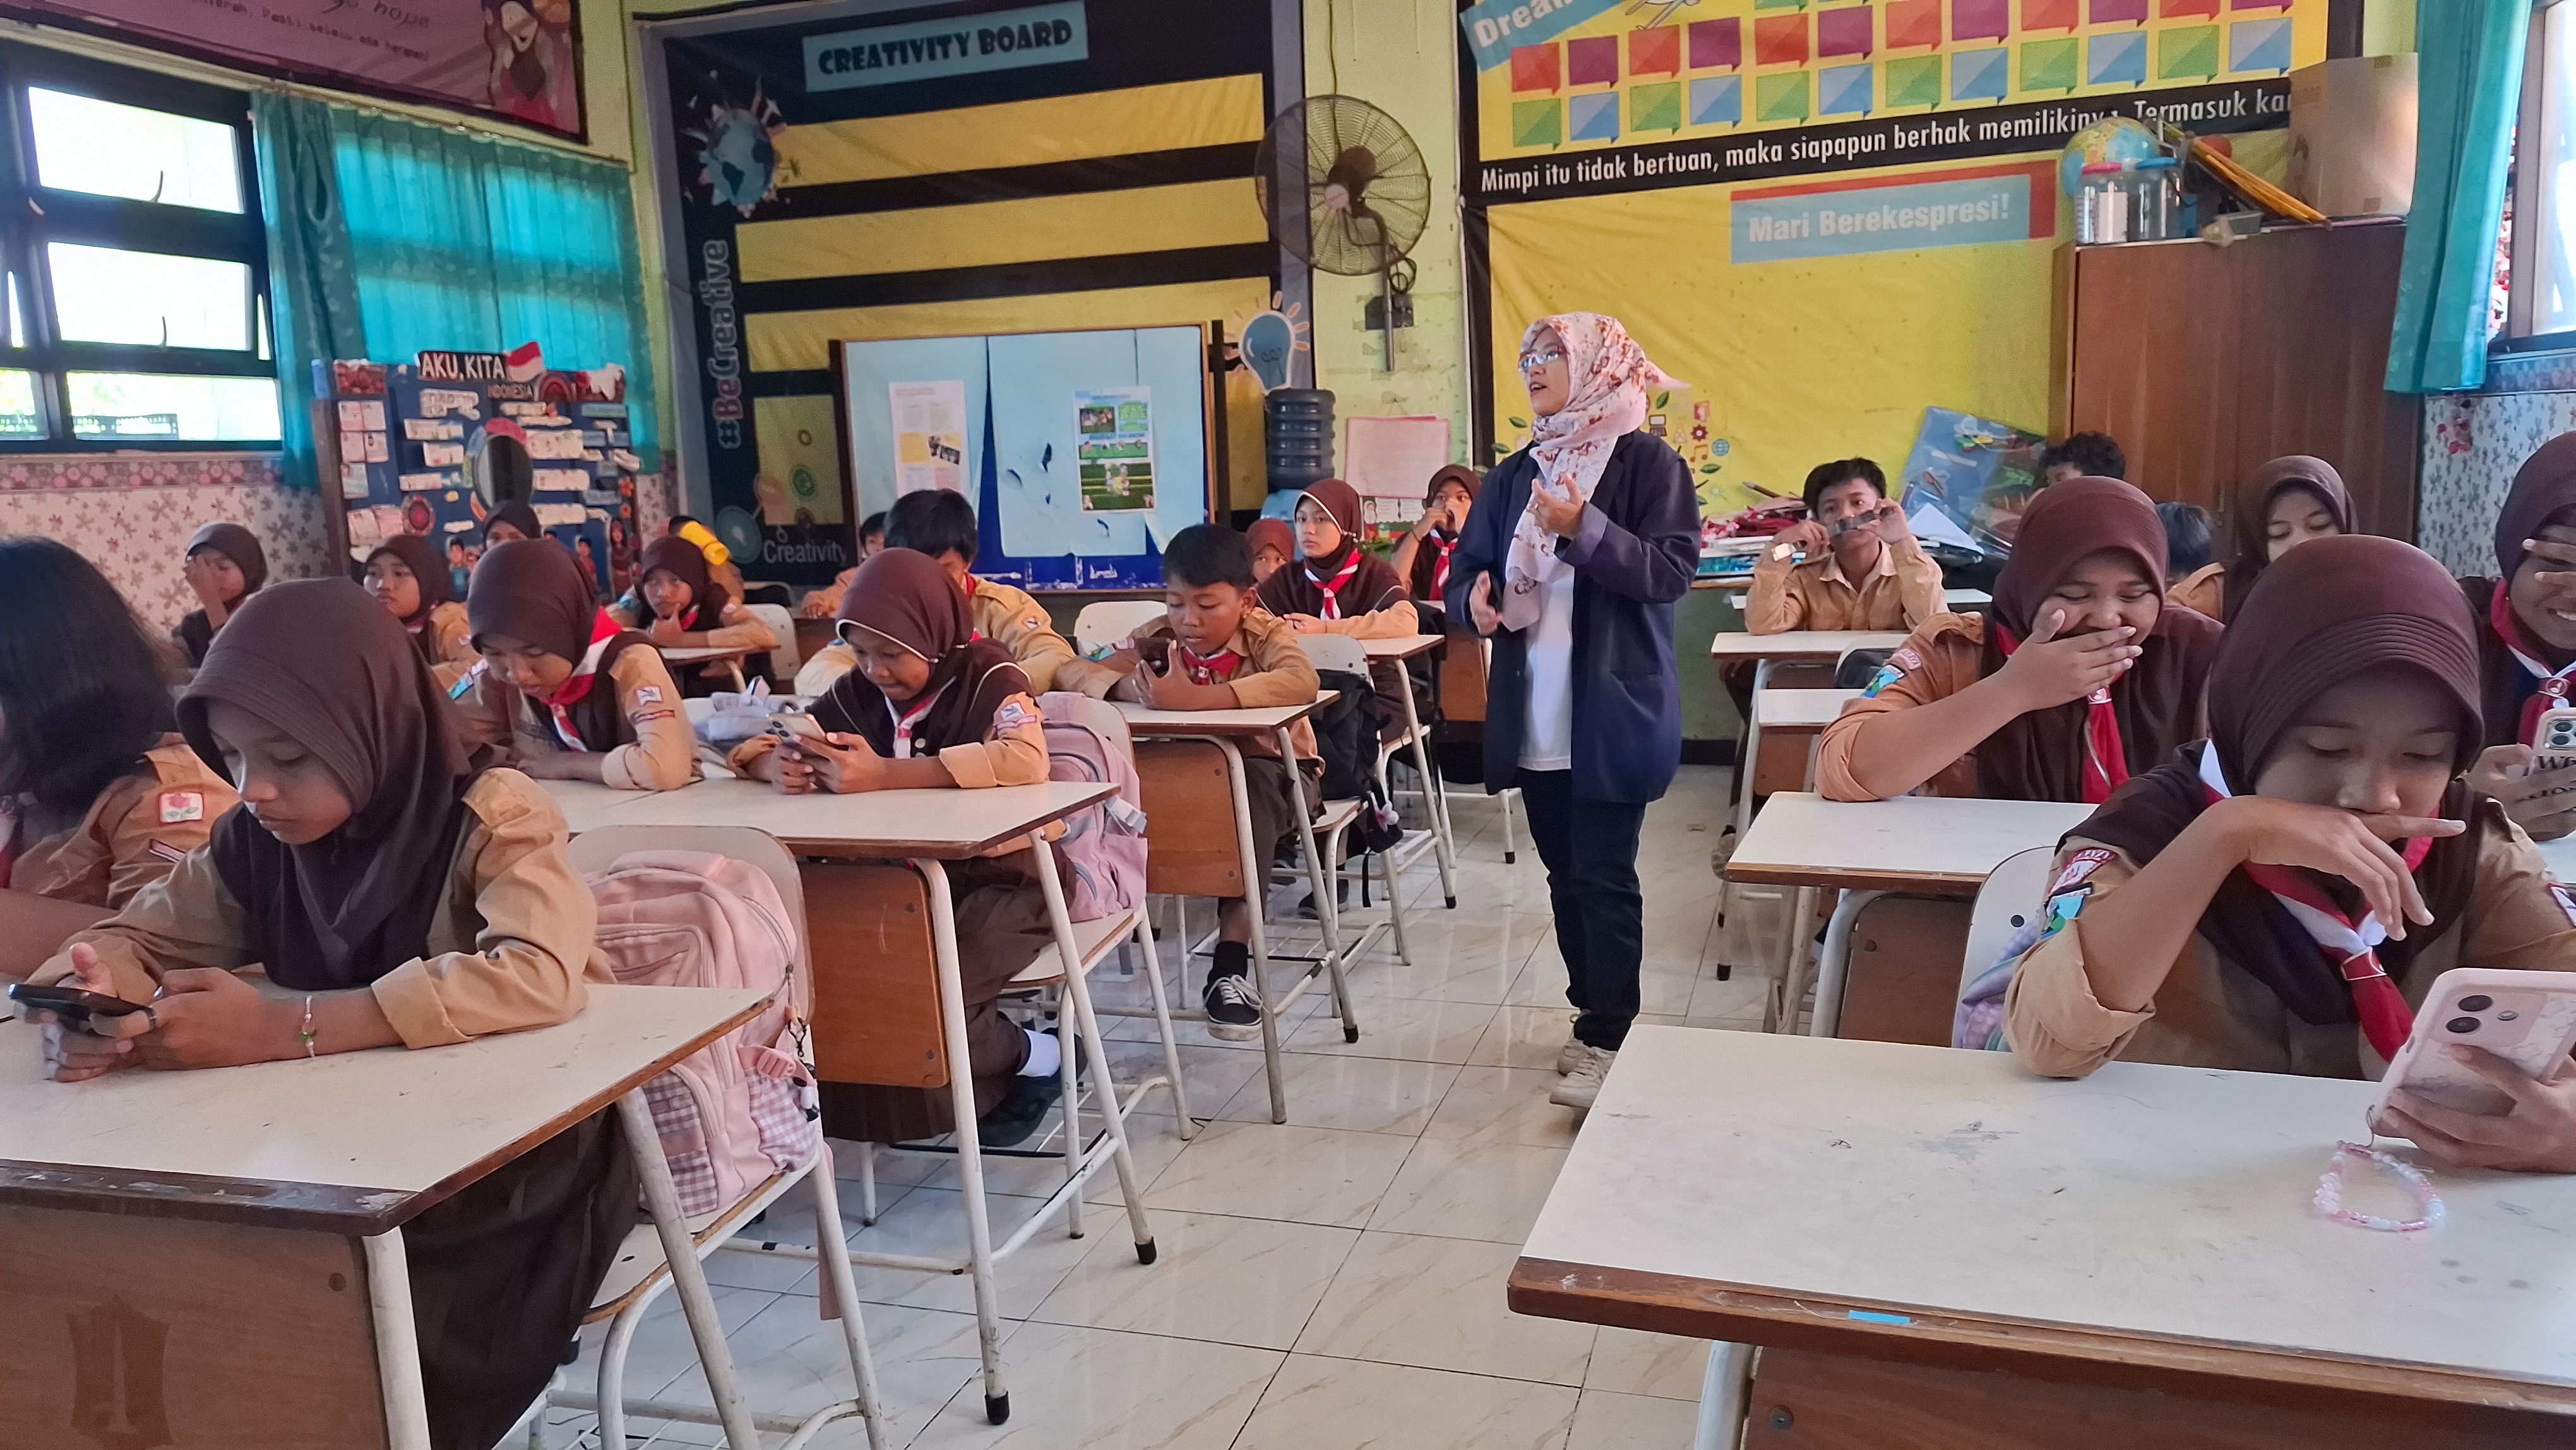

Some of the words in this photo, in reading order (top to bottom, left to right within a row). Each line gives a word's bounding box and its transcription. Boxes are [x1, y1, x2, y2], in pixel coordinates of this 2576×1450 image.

[818, 31, 971, 75] CREATIVITY
[978, 19, 1072, 55] BOARD
[1474, 0, 1573, 48] Drea
[1482, 165, 1539, 195] Mimpi
[1546, 163, 1570, 186] itu
[1578, 154, 1626, 183] tidak
[1634, 152, 1719, 176] bertuan,
[1726, 139, 1782, 167] maka
[1791, 133, 1886, 164] siapapun
[1894, 117, 1971, 149] berhak
[2134, 90, 2247, 123] Termasuk
[2255, 88, 2291, 114] ka
[1749, 212, 1810, 243] Mari
[1819, 193, 2010, 237] Berekespresi!
[465, 354, 506, 379] KITA
[763, 539, 847, 567] Creativity
